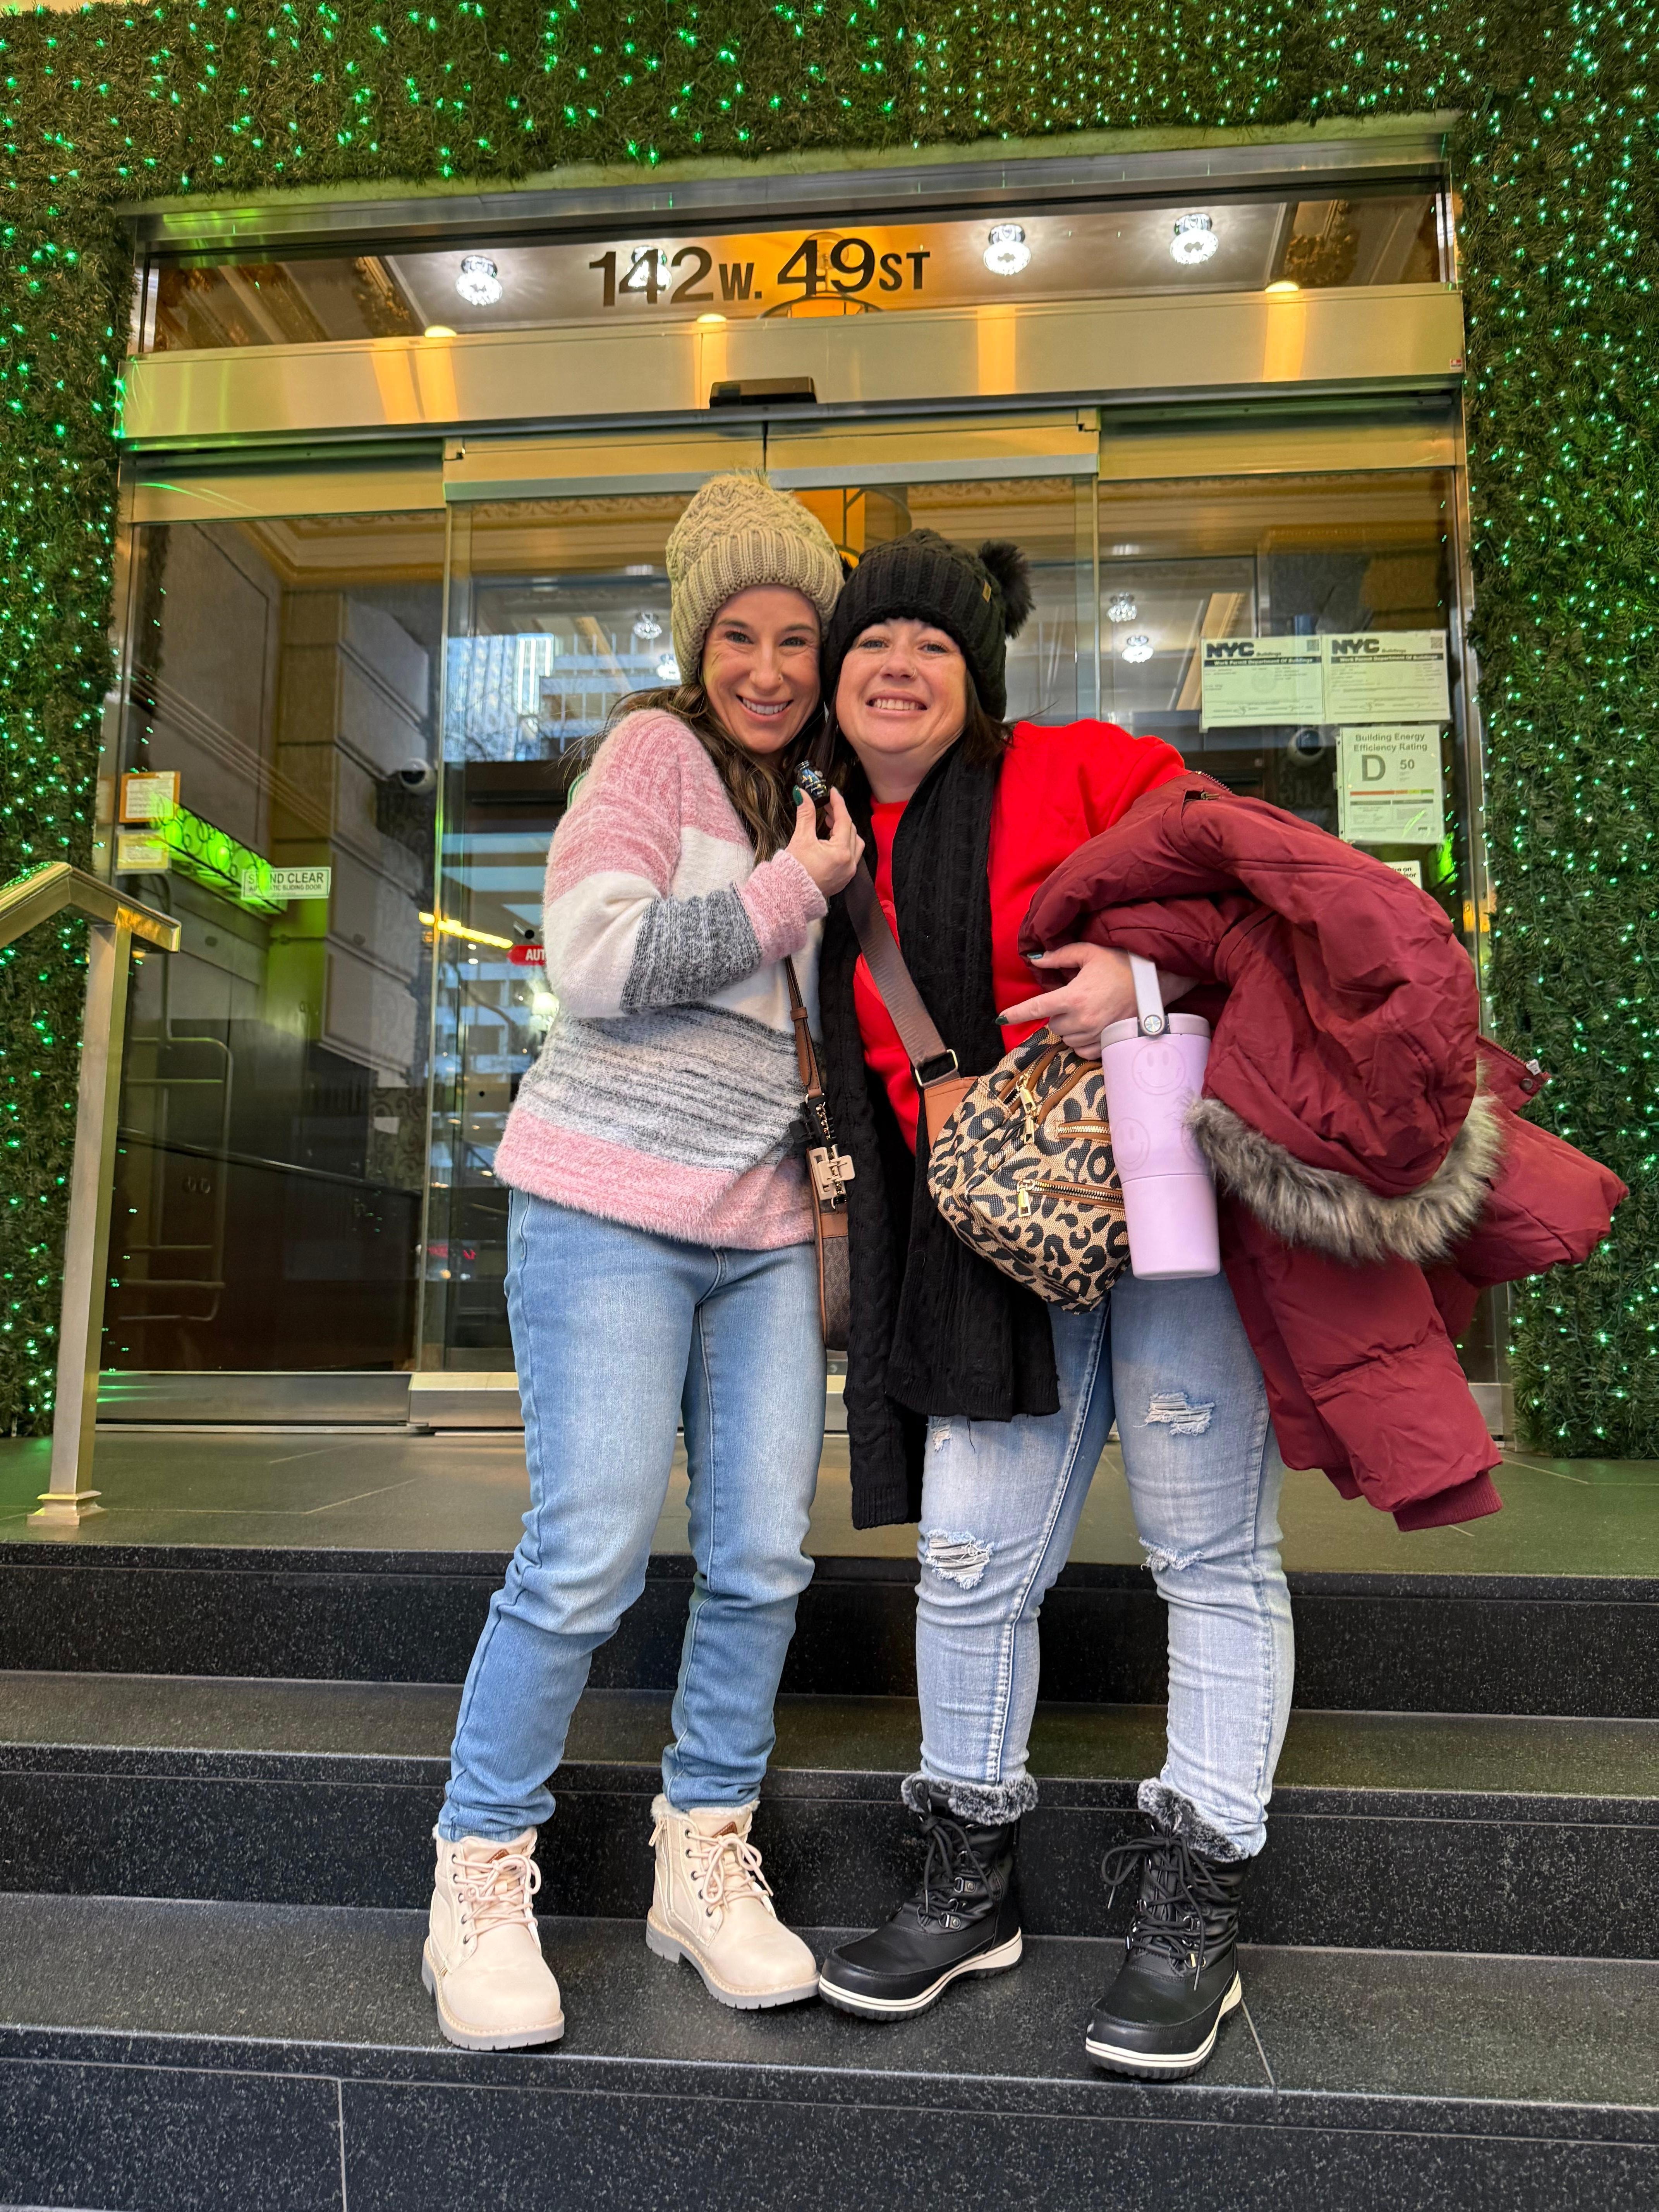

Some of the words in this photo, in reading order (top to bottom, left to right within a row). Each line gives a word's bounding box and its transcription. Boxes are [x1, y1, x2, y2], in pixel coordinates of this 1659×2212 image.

[589, 246, 713, 306] 142
[719, 263, 762, 301] W.
[778, 238, 875, 296] 49
[879, 251, 930, 291] ST
[1206, 642, 1254, 658] NYC
[1331, 639, 1379, 654] NYC
[1355, 734, 1392, 742] Building
[1395, 733, 1425, 741] Energy
[1354, 744, 1396, 752] Efficiency
[1399, 743, 1428, 751] Rating
[1362, 754, 1386, 781] D
[1400, 759, 1415, 770] 50
[248, 873, 284, 884] SND
[288, 872, 324, 883] CLEAR
